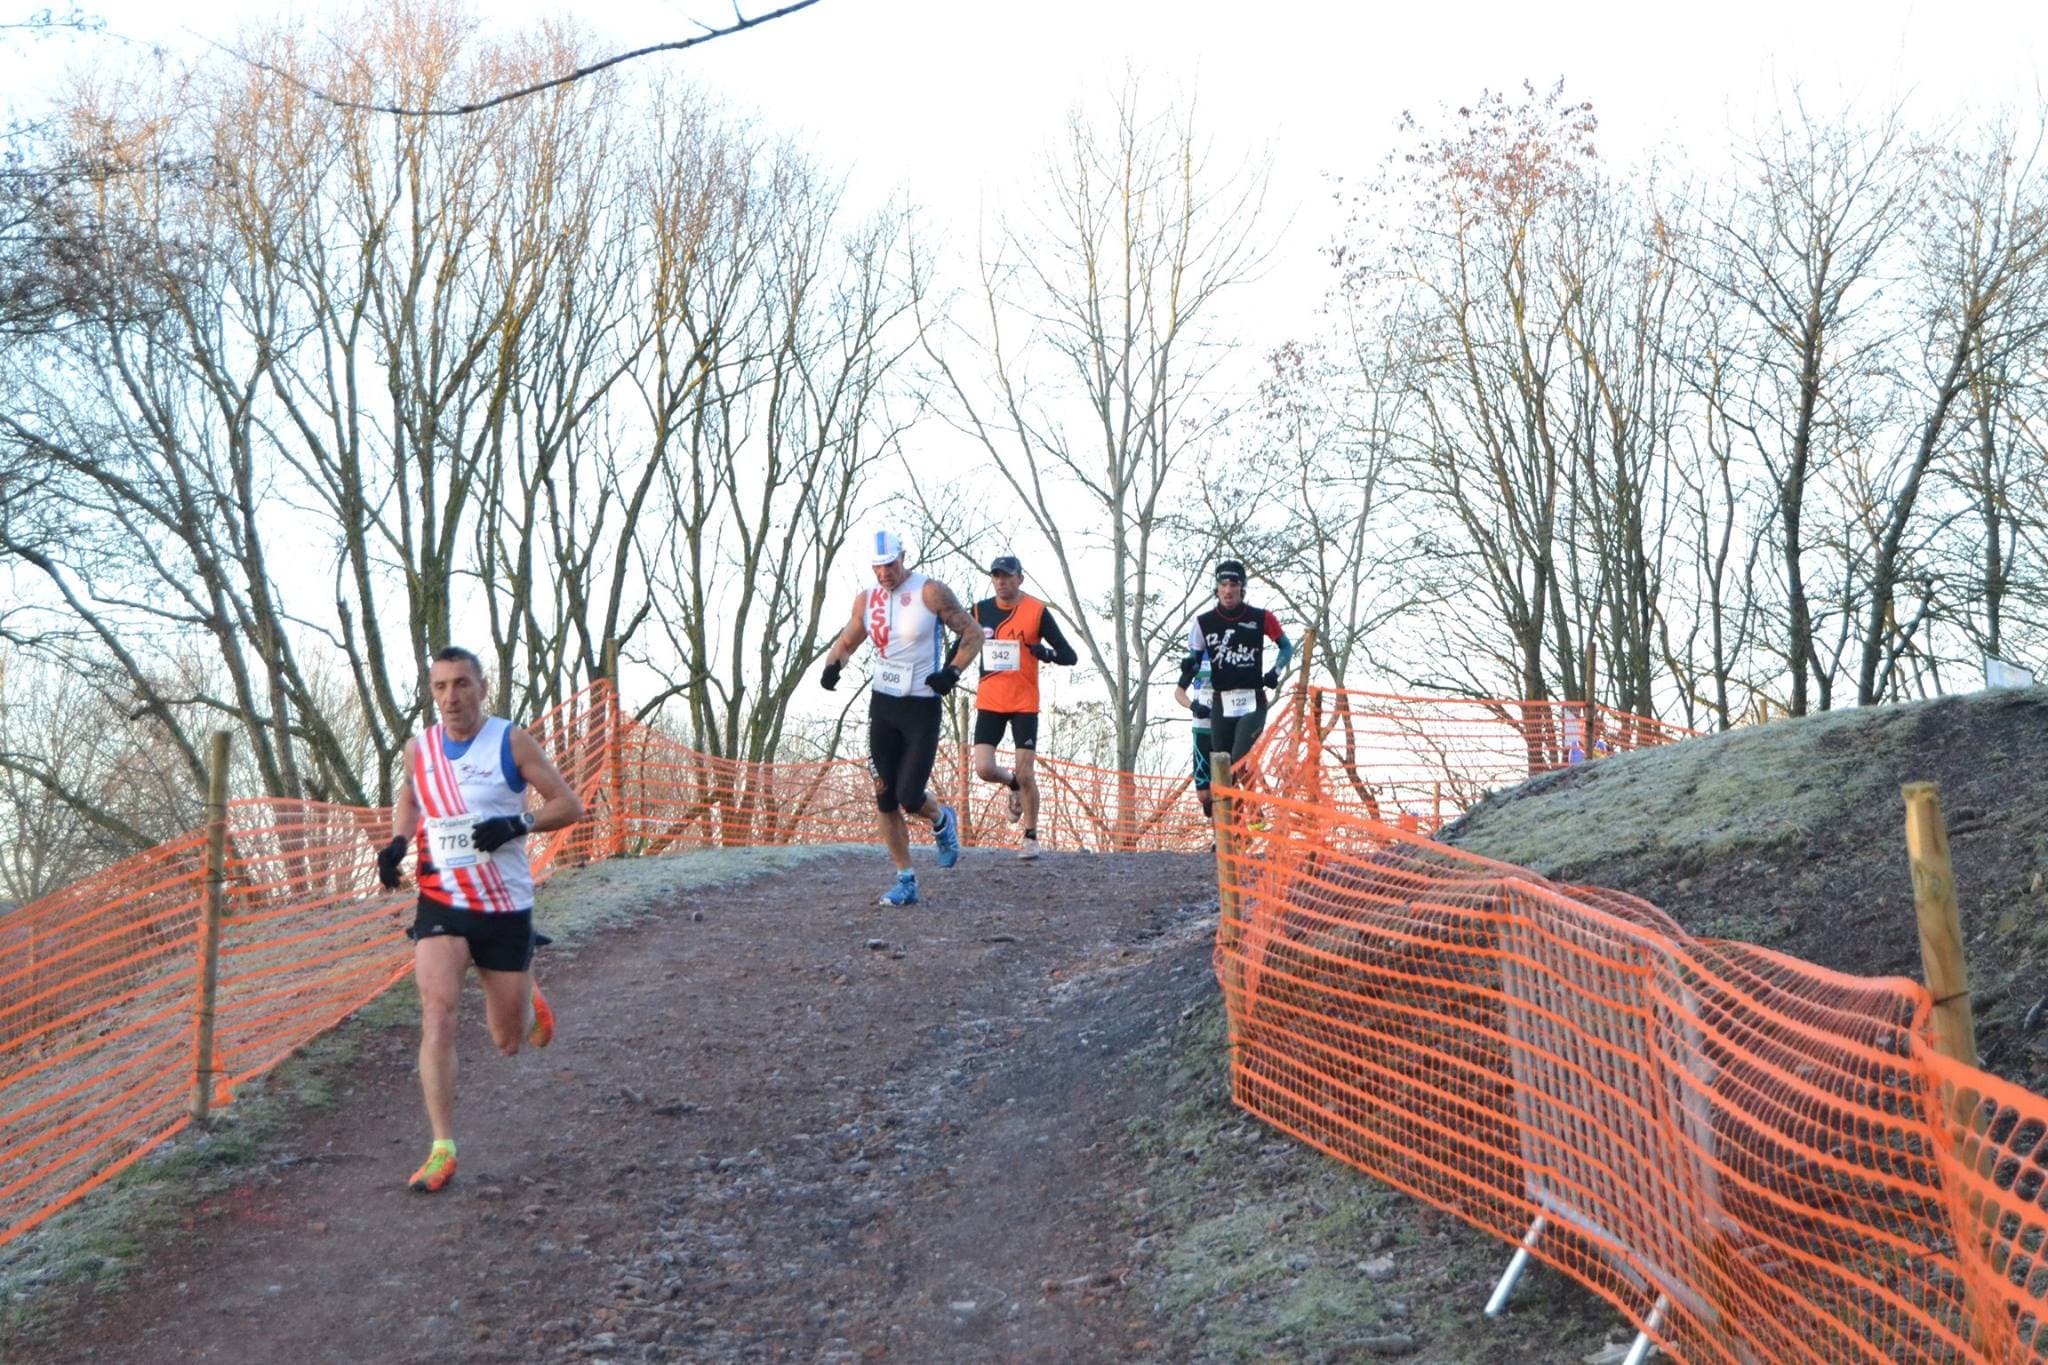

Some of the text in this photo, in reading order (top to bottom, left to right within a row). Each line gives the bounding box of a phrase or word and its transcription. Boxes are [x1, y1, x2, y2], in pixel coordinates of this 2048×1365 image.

[991, 650, 1010, 660] 342
[882, 671, 900, 684] 608
[1231, 698, 1247, 707] 122
[438, 833, 469, 850] 778
